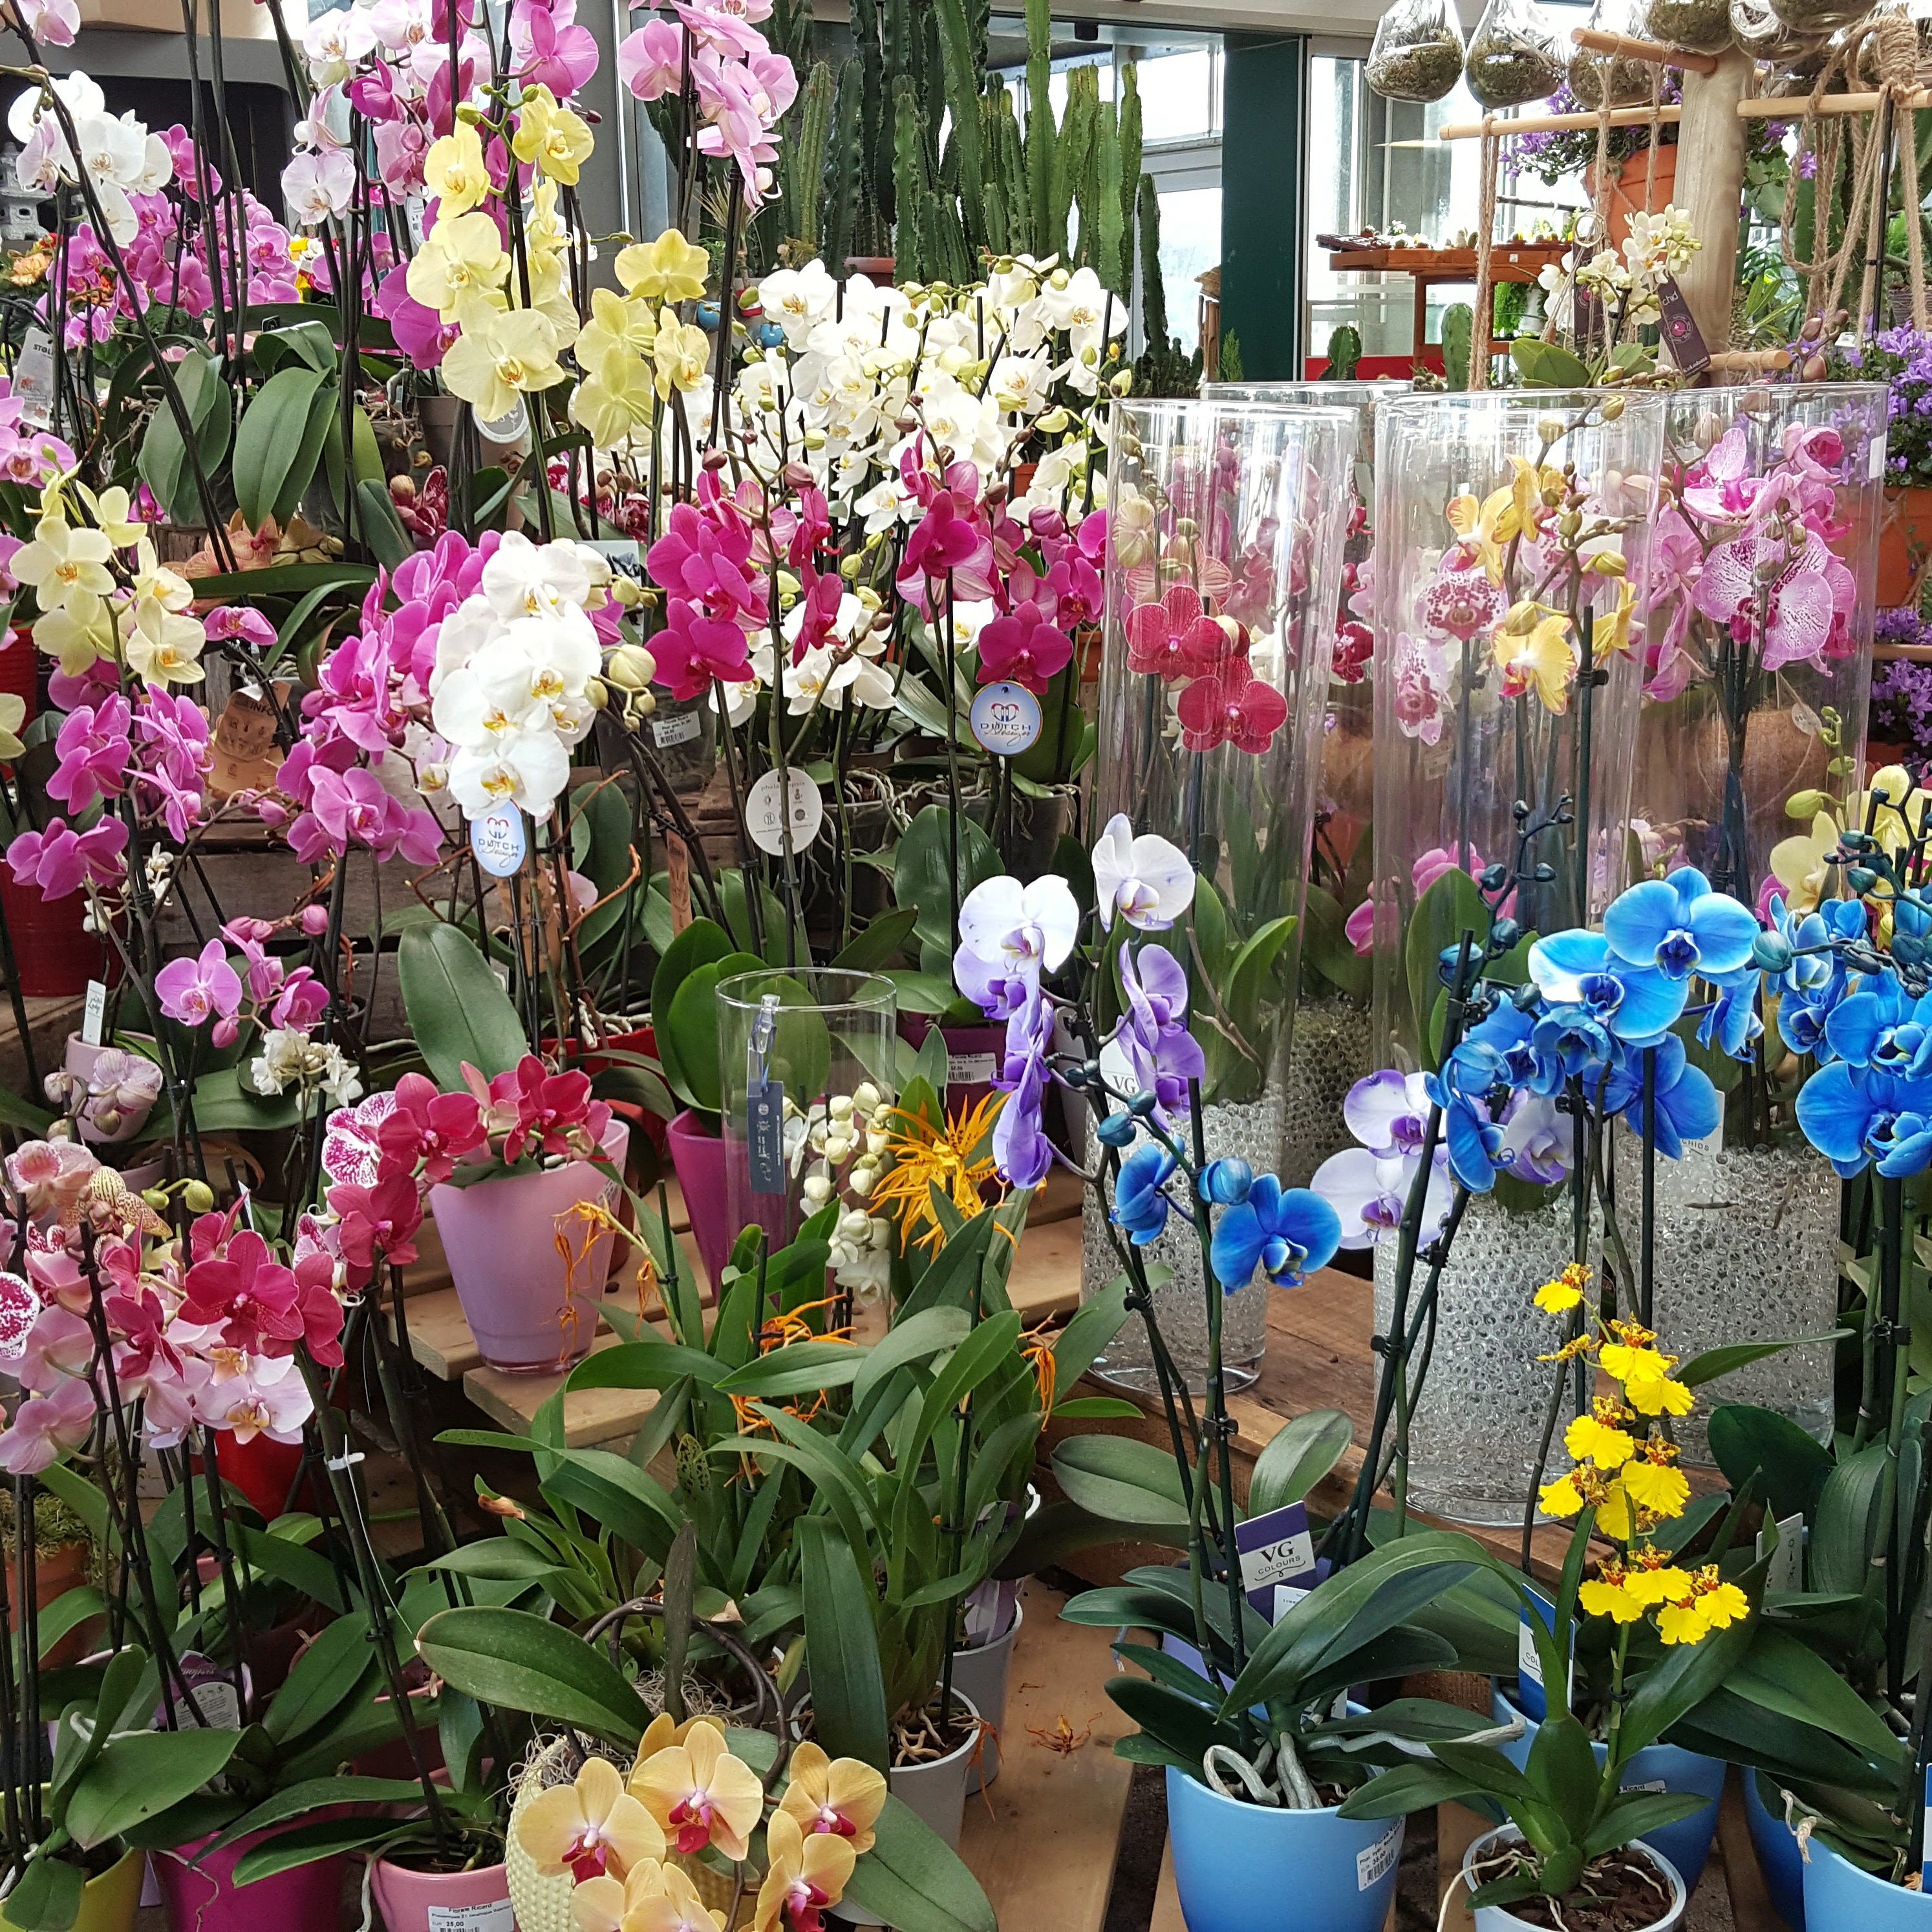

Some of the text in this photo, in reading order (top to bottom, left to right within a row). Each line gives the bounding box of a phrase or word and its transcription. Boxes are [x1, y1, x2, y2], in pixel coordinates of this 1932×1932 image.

[33, 343, 53, 355] STOL
[980, 723, 1031, 731] DUTCH
[478, 838, 519, 852] DUTCH
[1113, 1075, 1135, 1094] VG
[1682, 1139, 1710, 1152] CHIDS
[1259, 1540, 1294, 1563] VG
[1258, 1554, 1301, 1574] COLOURS
